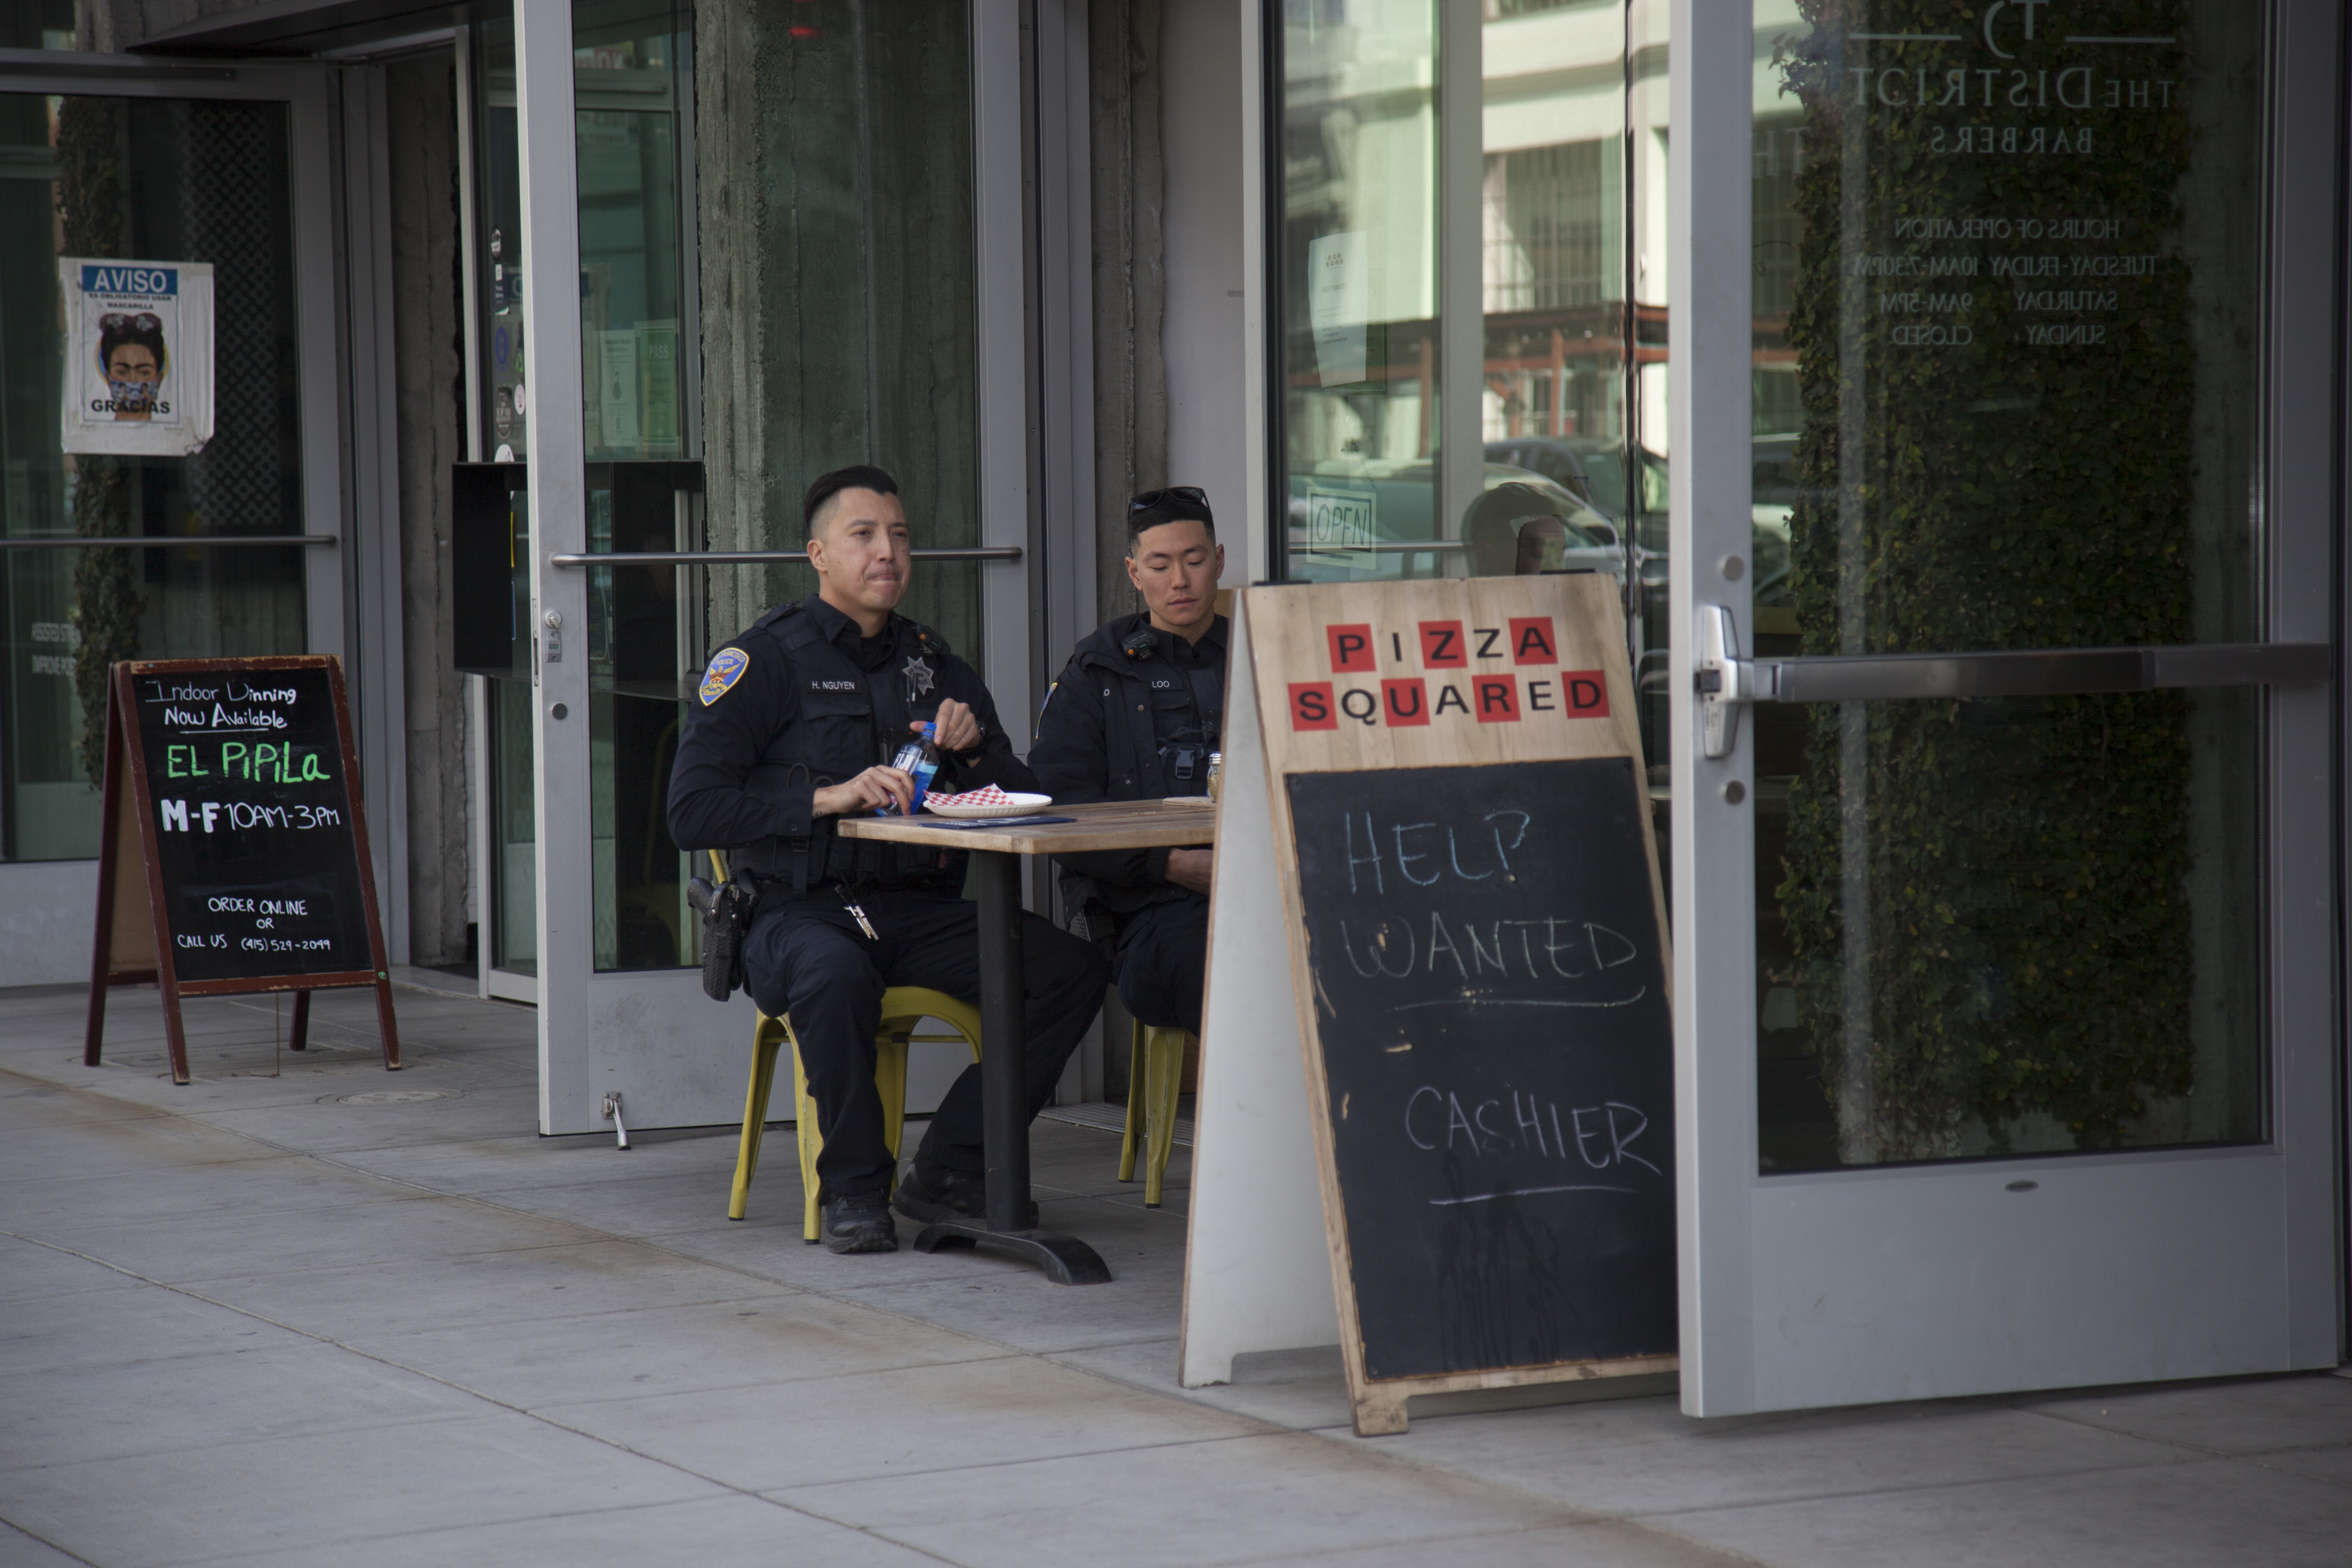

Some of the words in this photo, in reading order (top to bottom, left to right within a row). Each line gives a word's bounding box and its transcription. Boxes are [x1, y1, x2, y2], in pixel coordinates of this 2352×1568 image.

[94, 268, 167, 293] AVISO
[107, 301, 154, 310] MASCARILLA
[649, 344, 669, 359] PASS
[91, 399, 171, 415] GRACIAS
[1316, 503, 1368, 546] OPEN
[1338, 626, 1553, 665] PIZZA
[146, 680, 219, 703] Indoor
[811, 680, 821, 690] H.
[821, 680, 856, 690] NGUYEN
[1151, 680, 1170, 688] LOO
[1298, 678, 1602, 726] SQUARED
[164, 705, 206, 725] Now
[211, 702, 288, 729] Available
[167, 745, 209, 778] EL
[160, 799, 220, 833] M-F
[1344, 809, 1531, 894] HELP
[208, 897, 255, 913] ORDER
[259, 900, 308, 916] ONLINE
[256, 917, 275, 930] OR
[177, 934, 206, 949] CALL
[210, 933, 228, 949] US
[1340, 911, 1637, 980] WANTED
[1405, 1086, 1664, 1176] CASHIER
